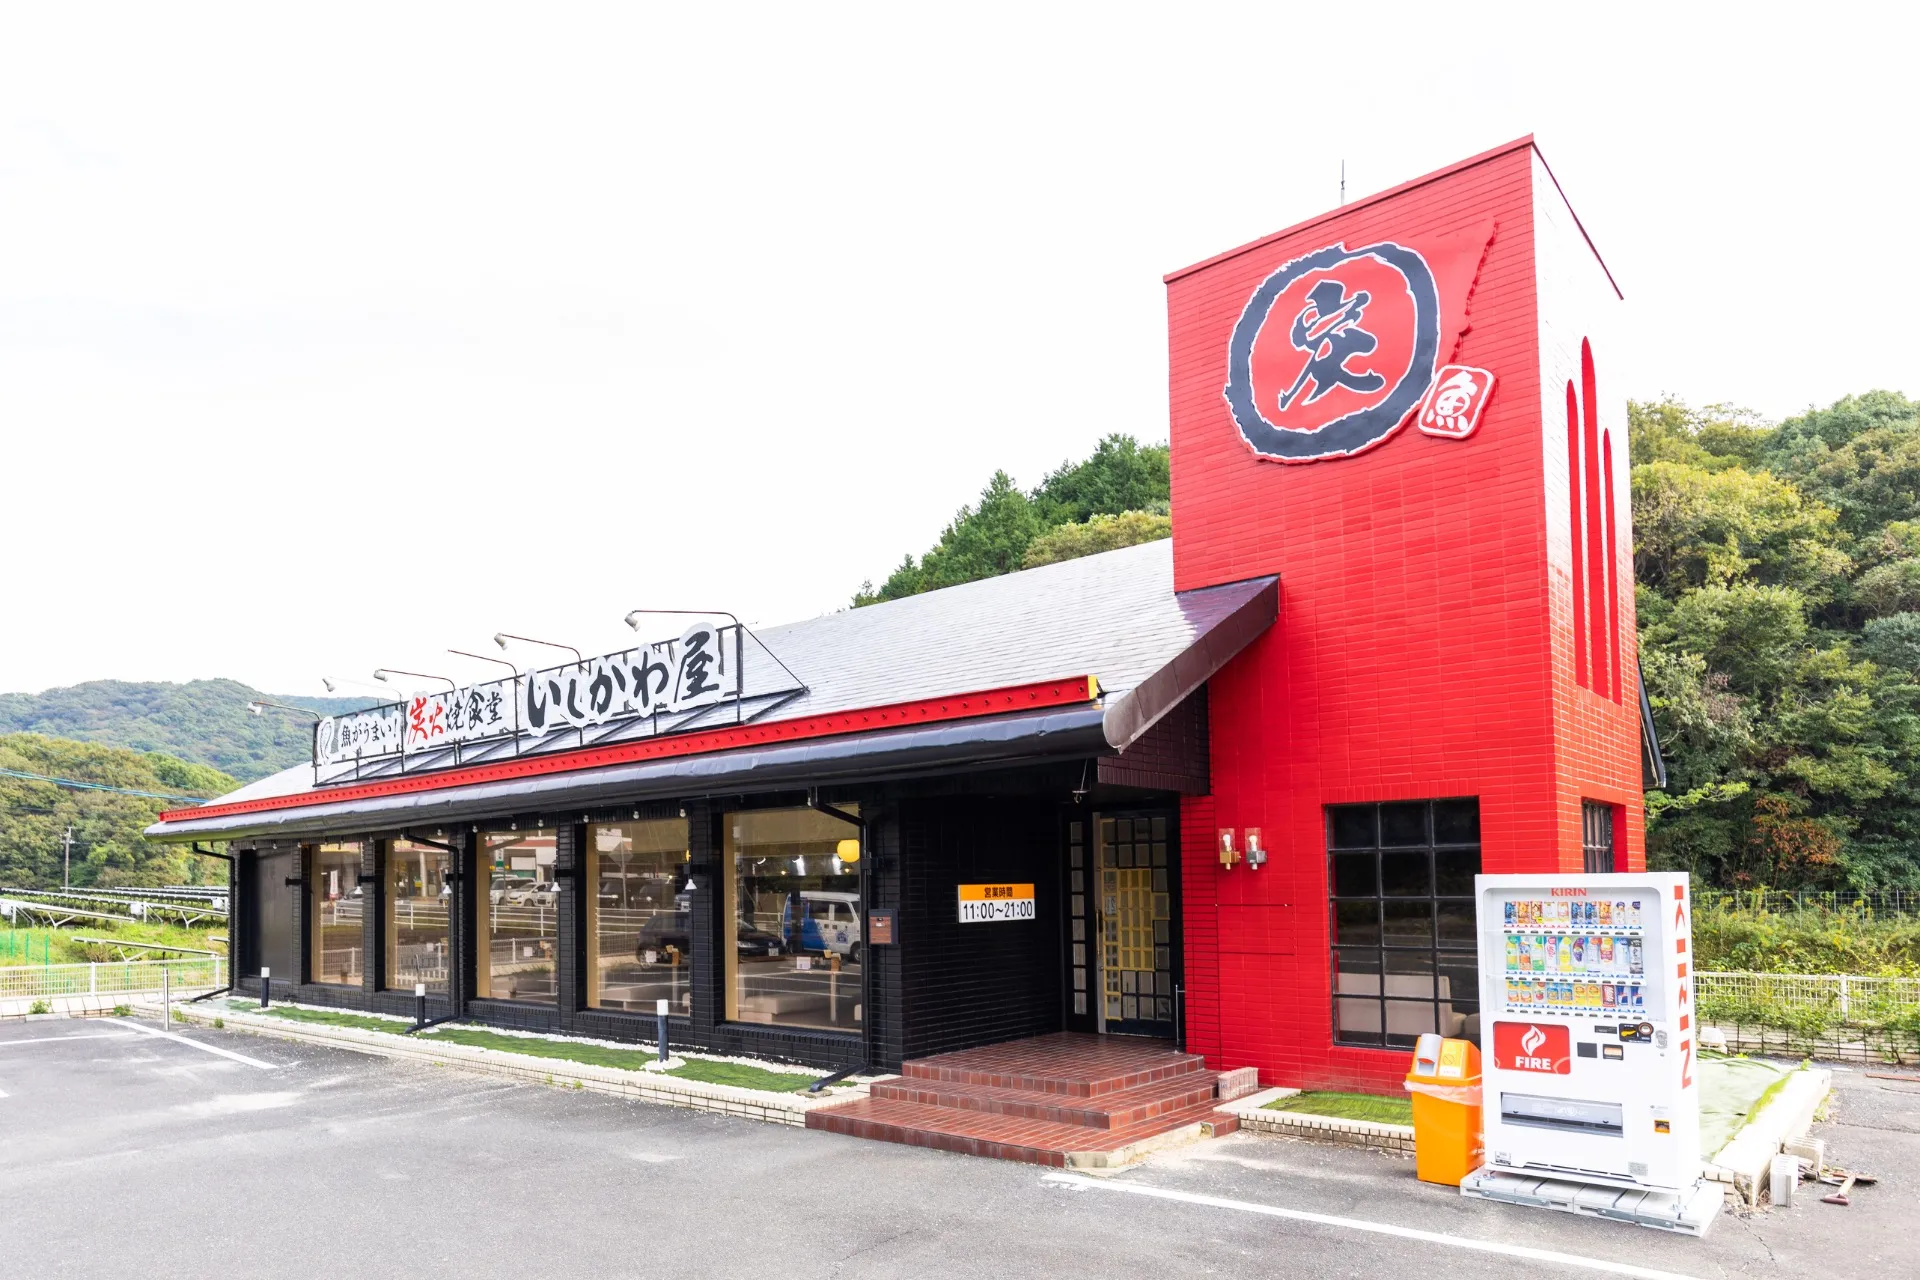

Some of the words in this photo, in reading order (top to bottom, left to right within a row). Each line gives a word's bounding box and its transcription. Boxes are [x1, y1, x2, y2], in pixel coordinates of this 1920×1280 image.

[1426, 370, 1478, 431] 魚
[407, 689, 503, 744] 炭火焼食堂
[527, 631, 720, 729] いしかわ屋
[984, 886, 1013, 898] 営業時間
[1551, 888, 1587, 897] KIRIN
[1673, 885, 1692, 1090] KIRIN
[1515, 1055, 1552, 1071] FIRE
